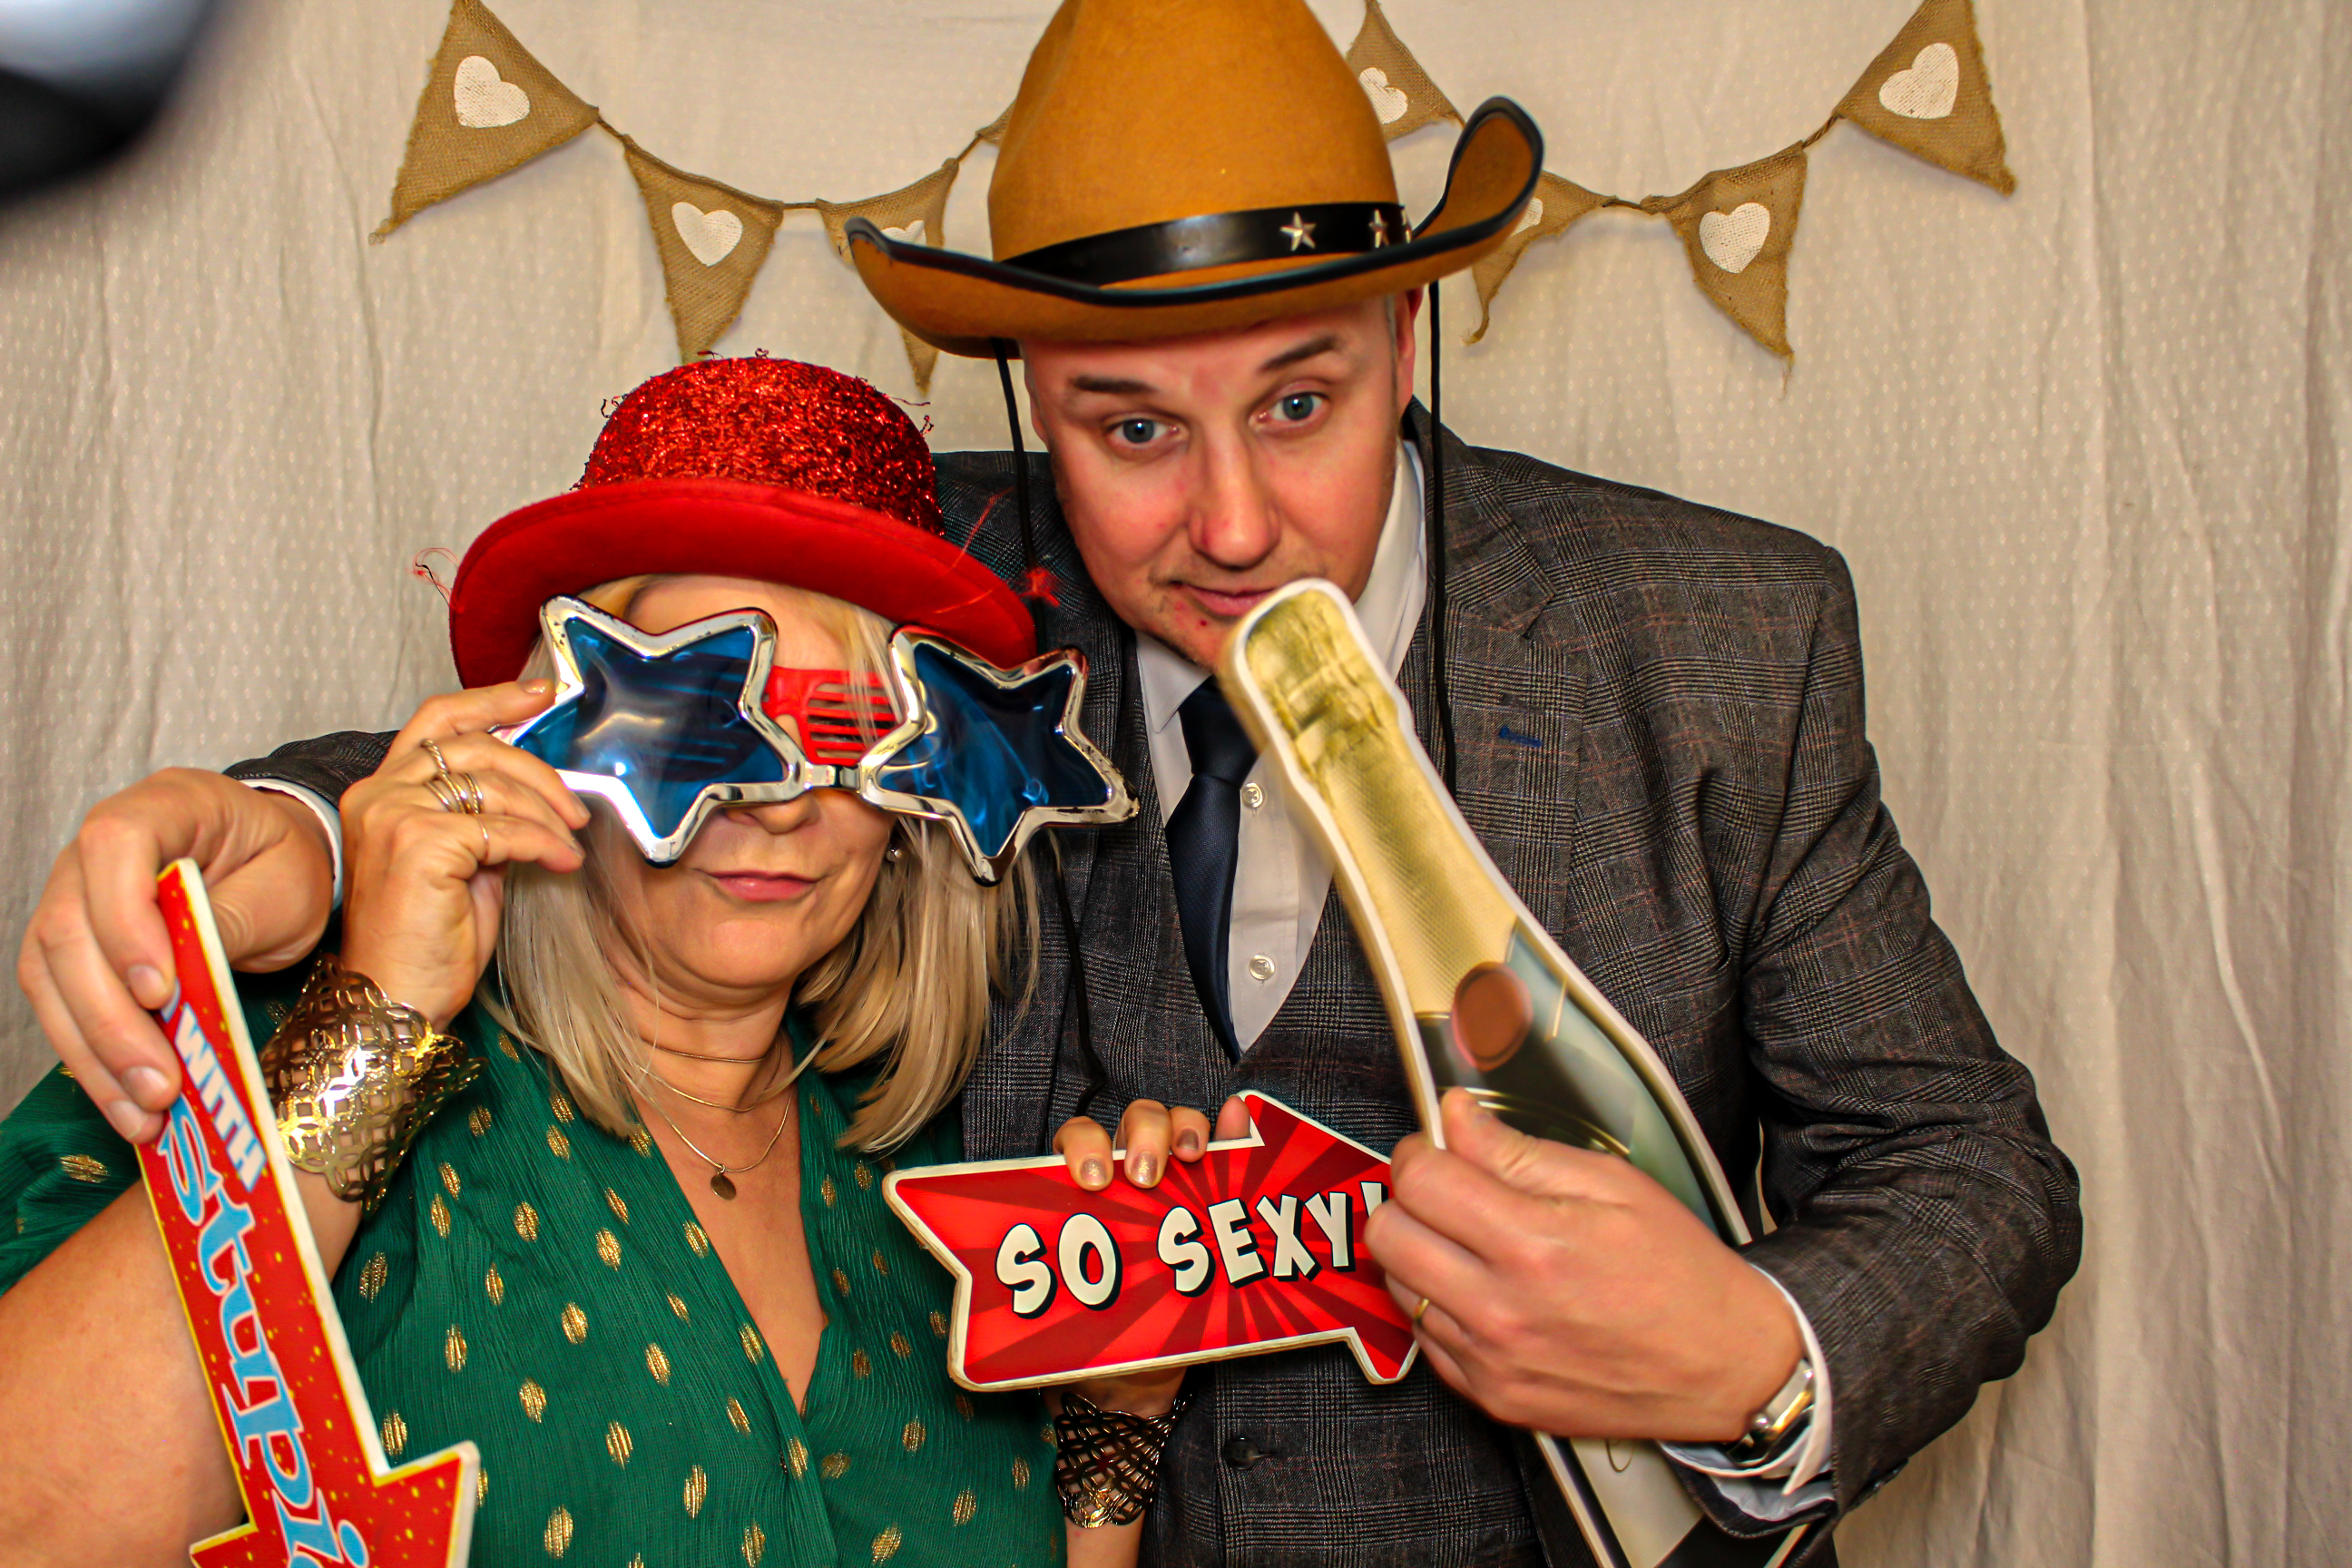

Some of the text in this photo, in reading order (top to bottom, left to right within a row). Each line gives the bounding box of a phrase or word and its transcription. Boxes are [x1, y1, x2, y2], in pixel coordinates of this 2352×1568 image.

[173, 1002, 267, 1193] WITH
[157, 1093, 370, 1568] stupi
[995, 1212, 1122, 1318] SO
